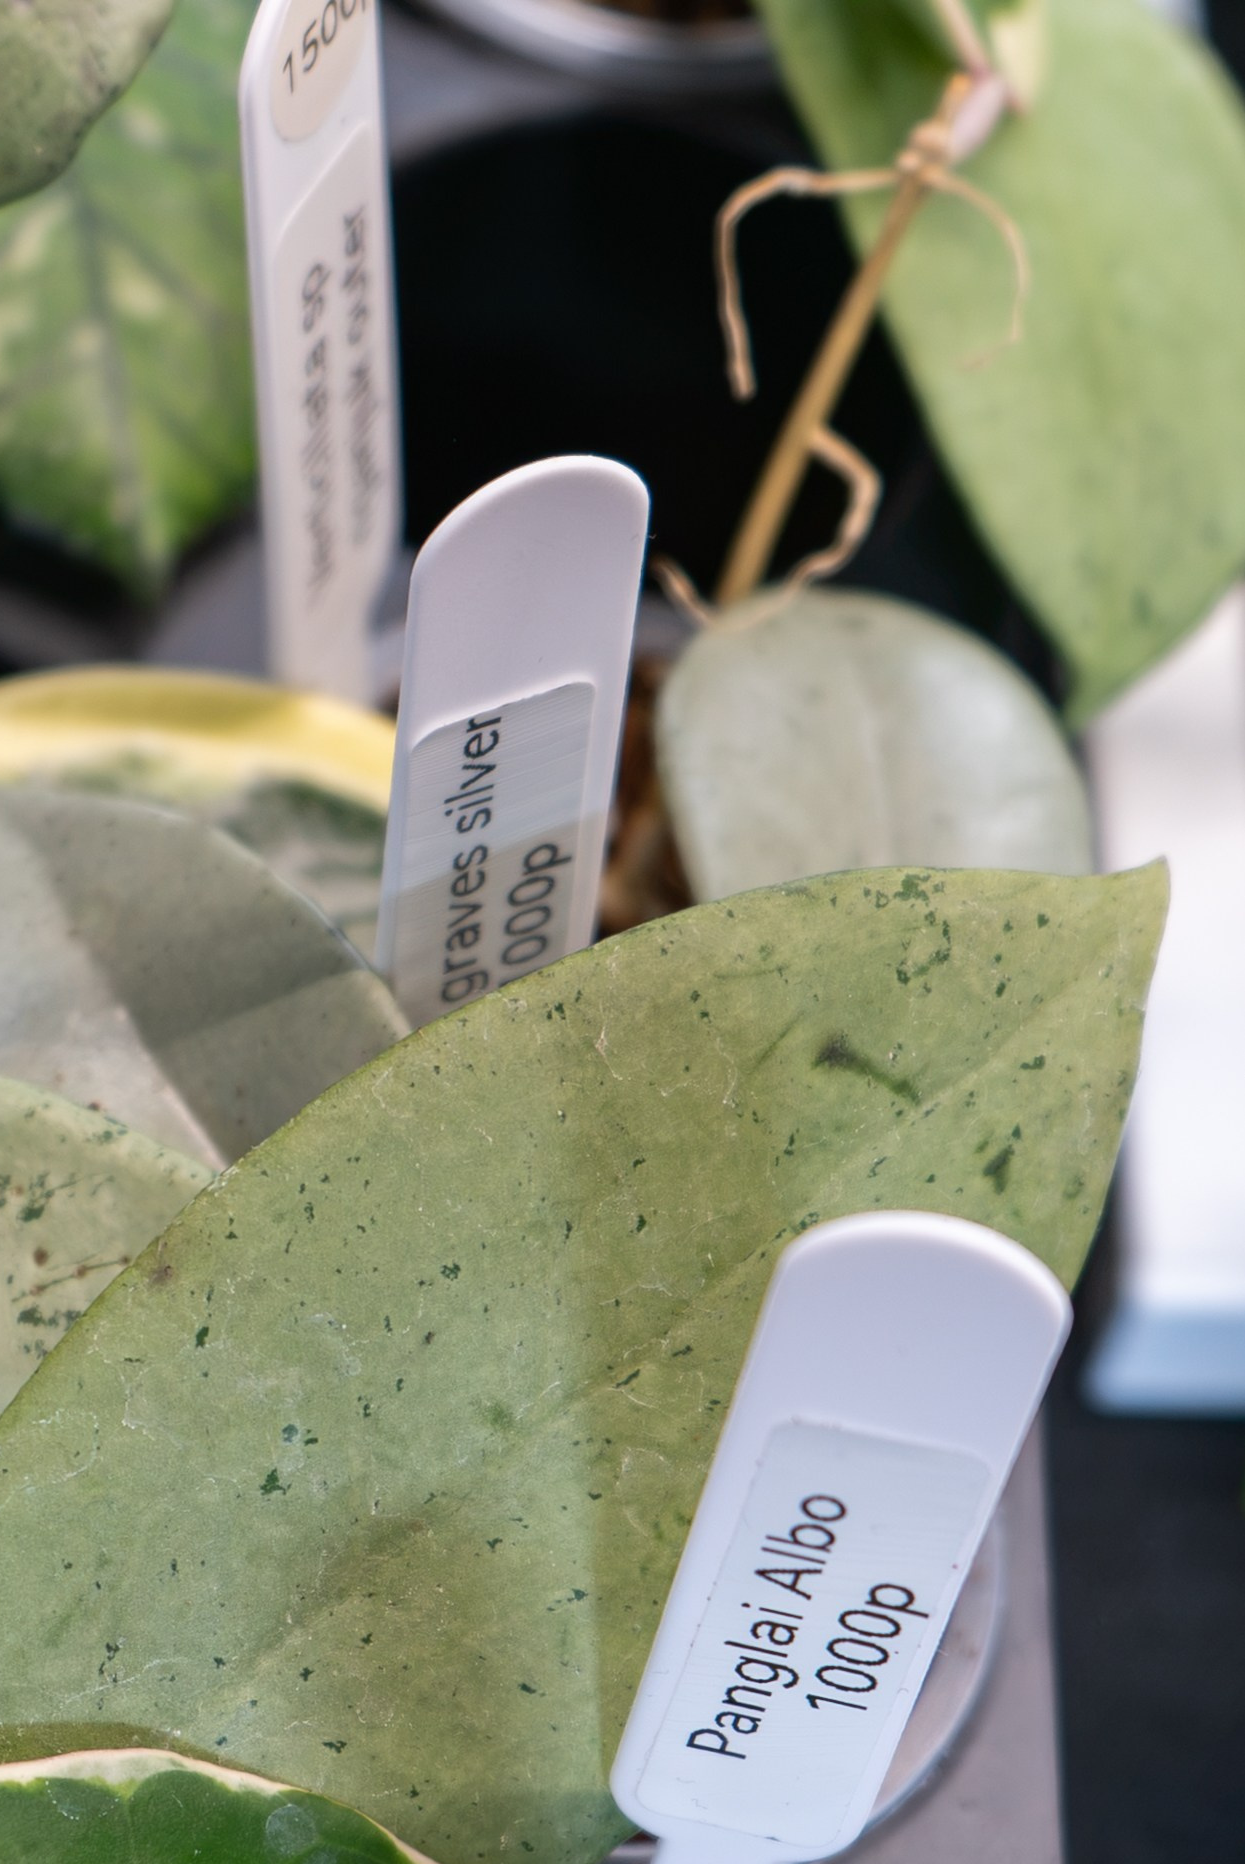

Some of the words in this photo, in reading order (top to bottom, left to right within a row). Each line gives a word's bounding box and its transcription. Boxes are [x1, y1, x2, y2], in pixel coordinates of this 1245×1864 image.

[443, 714, 503, 835] silver
[685, 1602, 804, 1760] Panglai
[754, 1494, 848, 1600] Albo
[806, 1583, 930, 1710] 1000p
